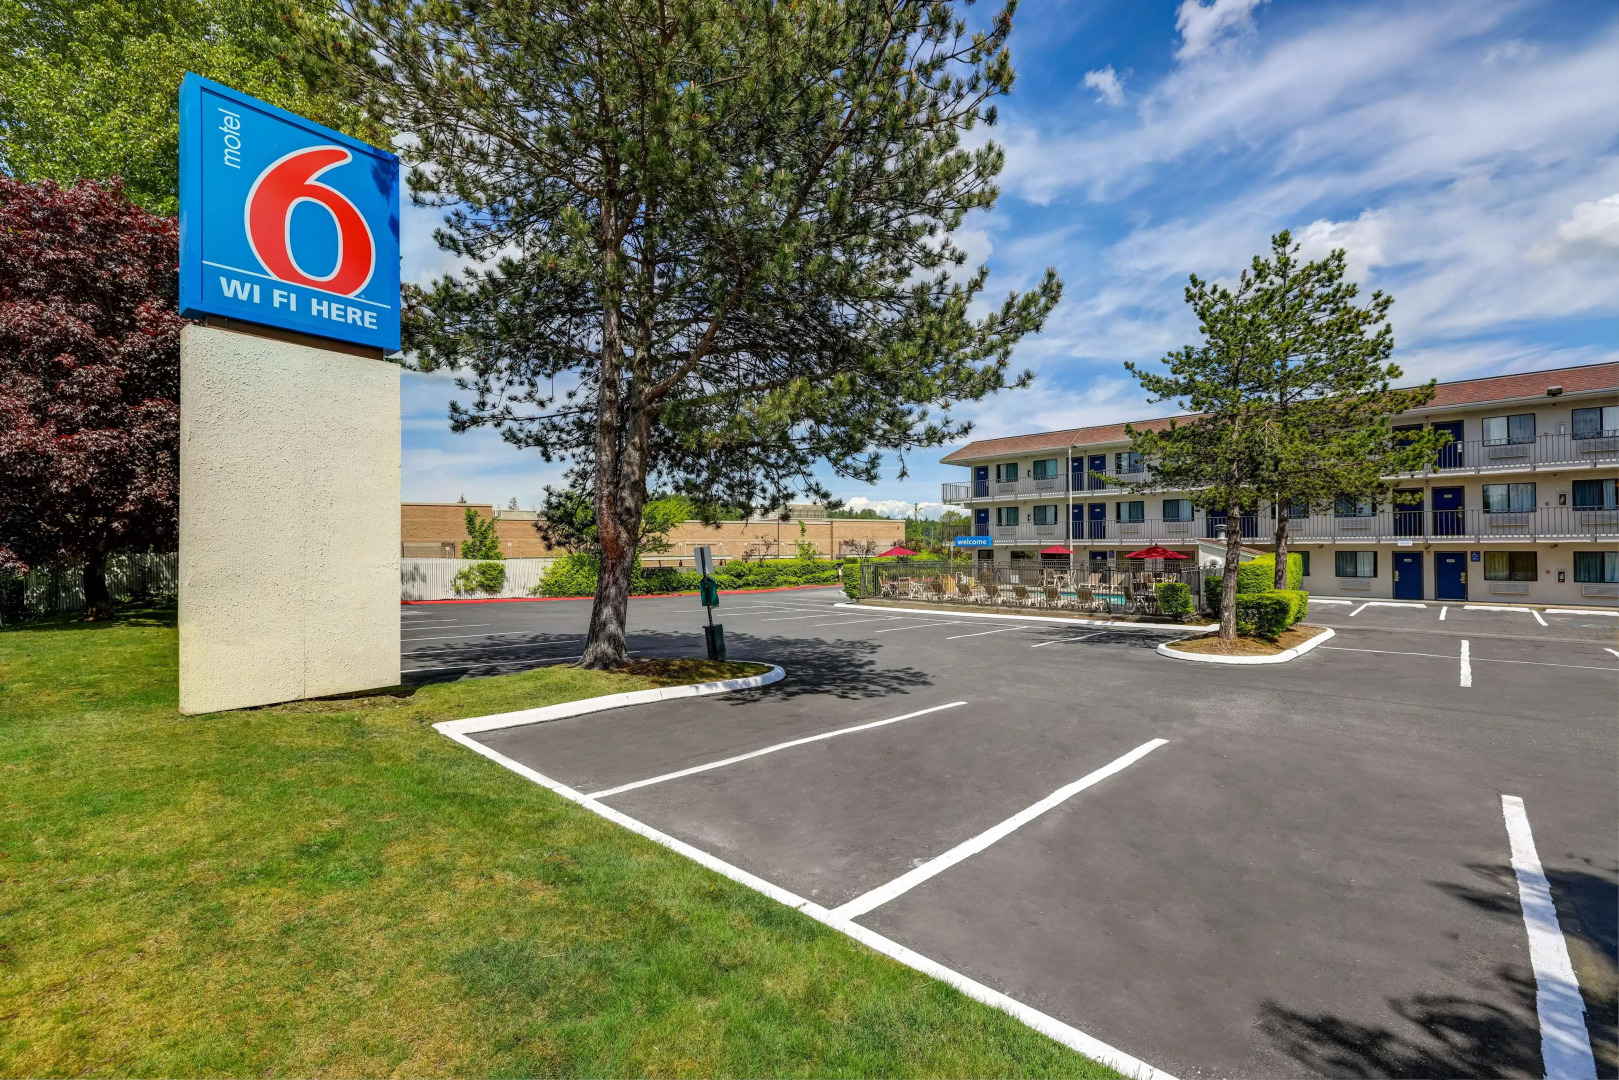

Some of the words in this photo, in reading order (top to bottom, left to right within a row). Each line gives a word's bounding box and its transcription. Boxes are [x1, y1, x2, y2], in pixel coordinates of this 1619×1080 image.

[218, 108, 241, 169] motel
[244, 145, 376, 297] 6
[219, 276, 260, 304] WI
[273, 289, 296, 312] FI
[311, 298, 378, 330] HERE
